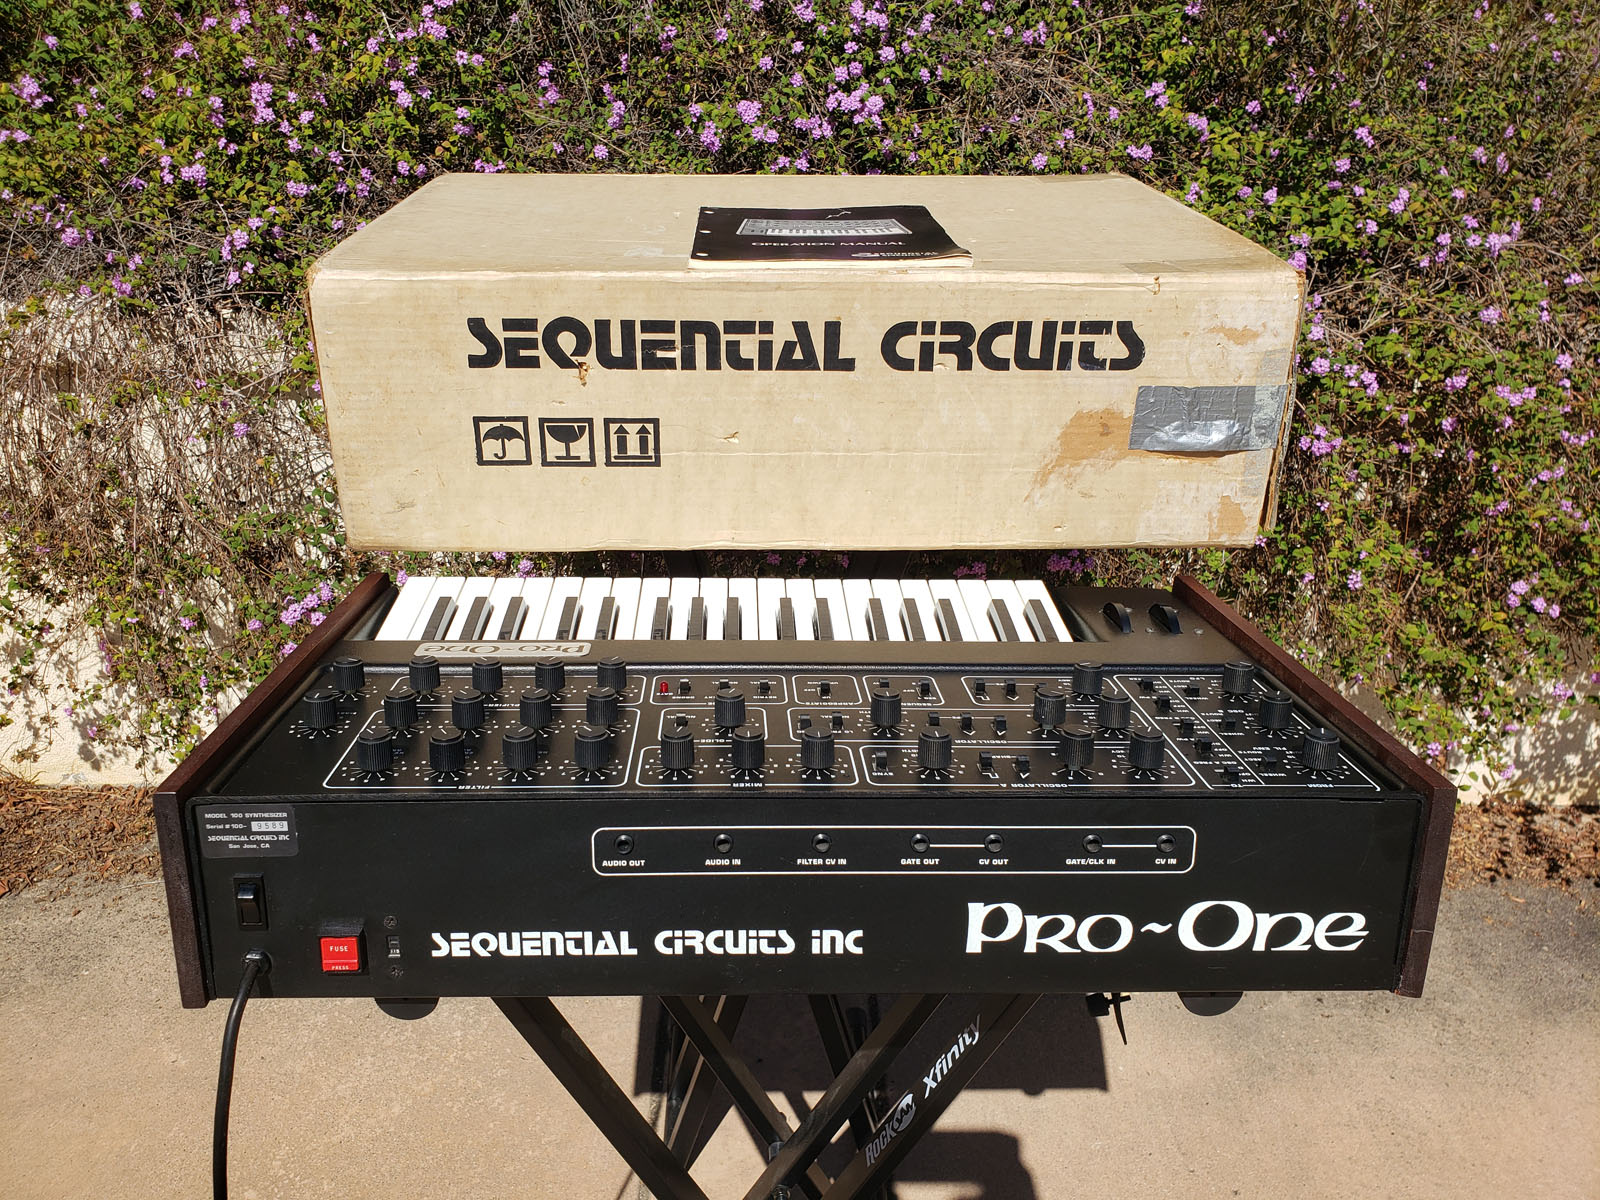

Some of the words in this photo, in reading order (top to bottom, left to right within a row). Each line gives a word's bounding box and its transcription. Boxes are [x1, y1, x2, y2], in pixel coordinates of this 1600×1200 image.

[467, 317, 855, 371] SEQUENTIAL
[256, 822, 284, 830] 9589
[602, 859, 627, 867] AUDIO
[705, 858, 731, 866] AUDIO
[732, 858, 741, 866] IN
[992, 858, 1009, 866] OUT
[431, 931, 637, 957] SEQUENTIAL
[923, 1013, 982, 1099] Xfinity
